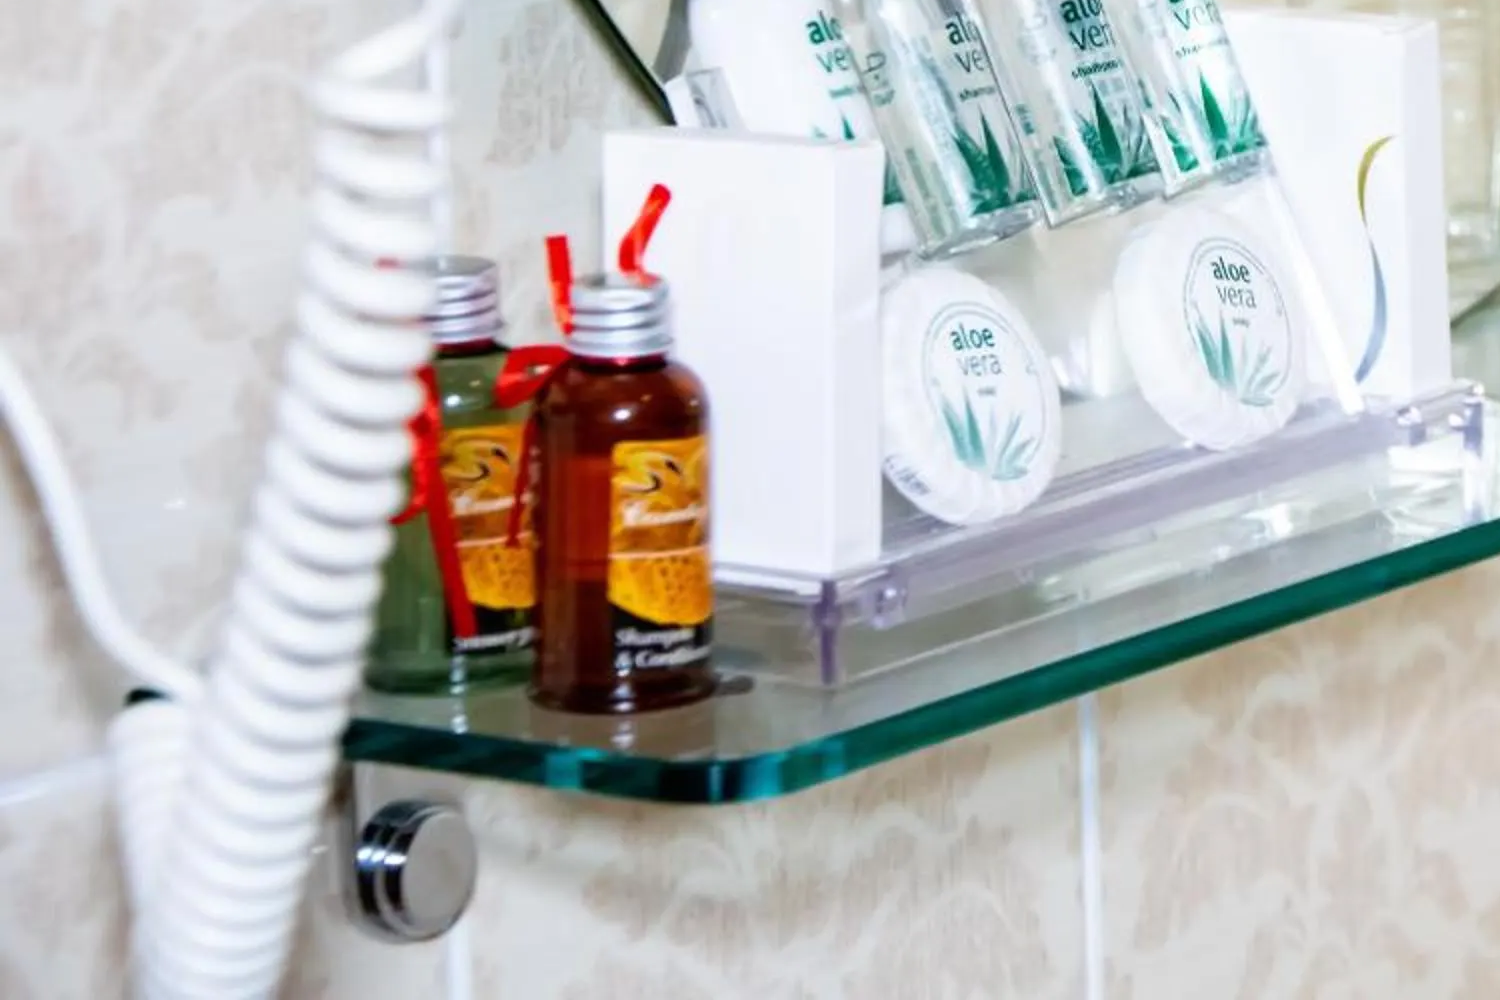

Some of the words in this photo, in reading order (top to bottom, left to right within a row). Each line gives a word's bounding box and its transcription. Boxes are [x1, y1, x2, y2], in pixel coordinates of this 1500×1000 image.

[1210, 255, 1252, 284] aloe
[1215, 285, 1258, 310] vera
[950, 321, 996, 351] aloe
[955, 353, 1003, 377] vera
